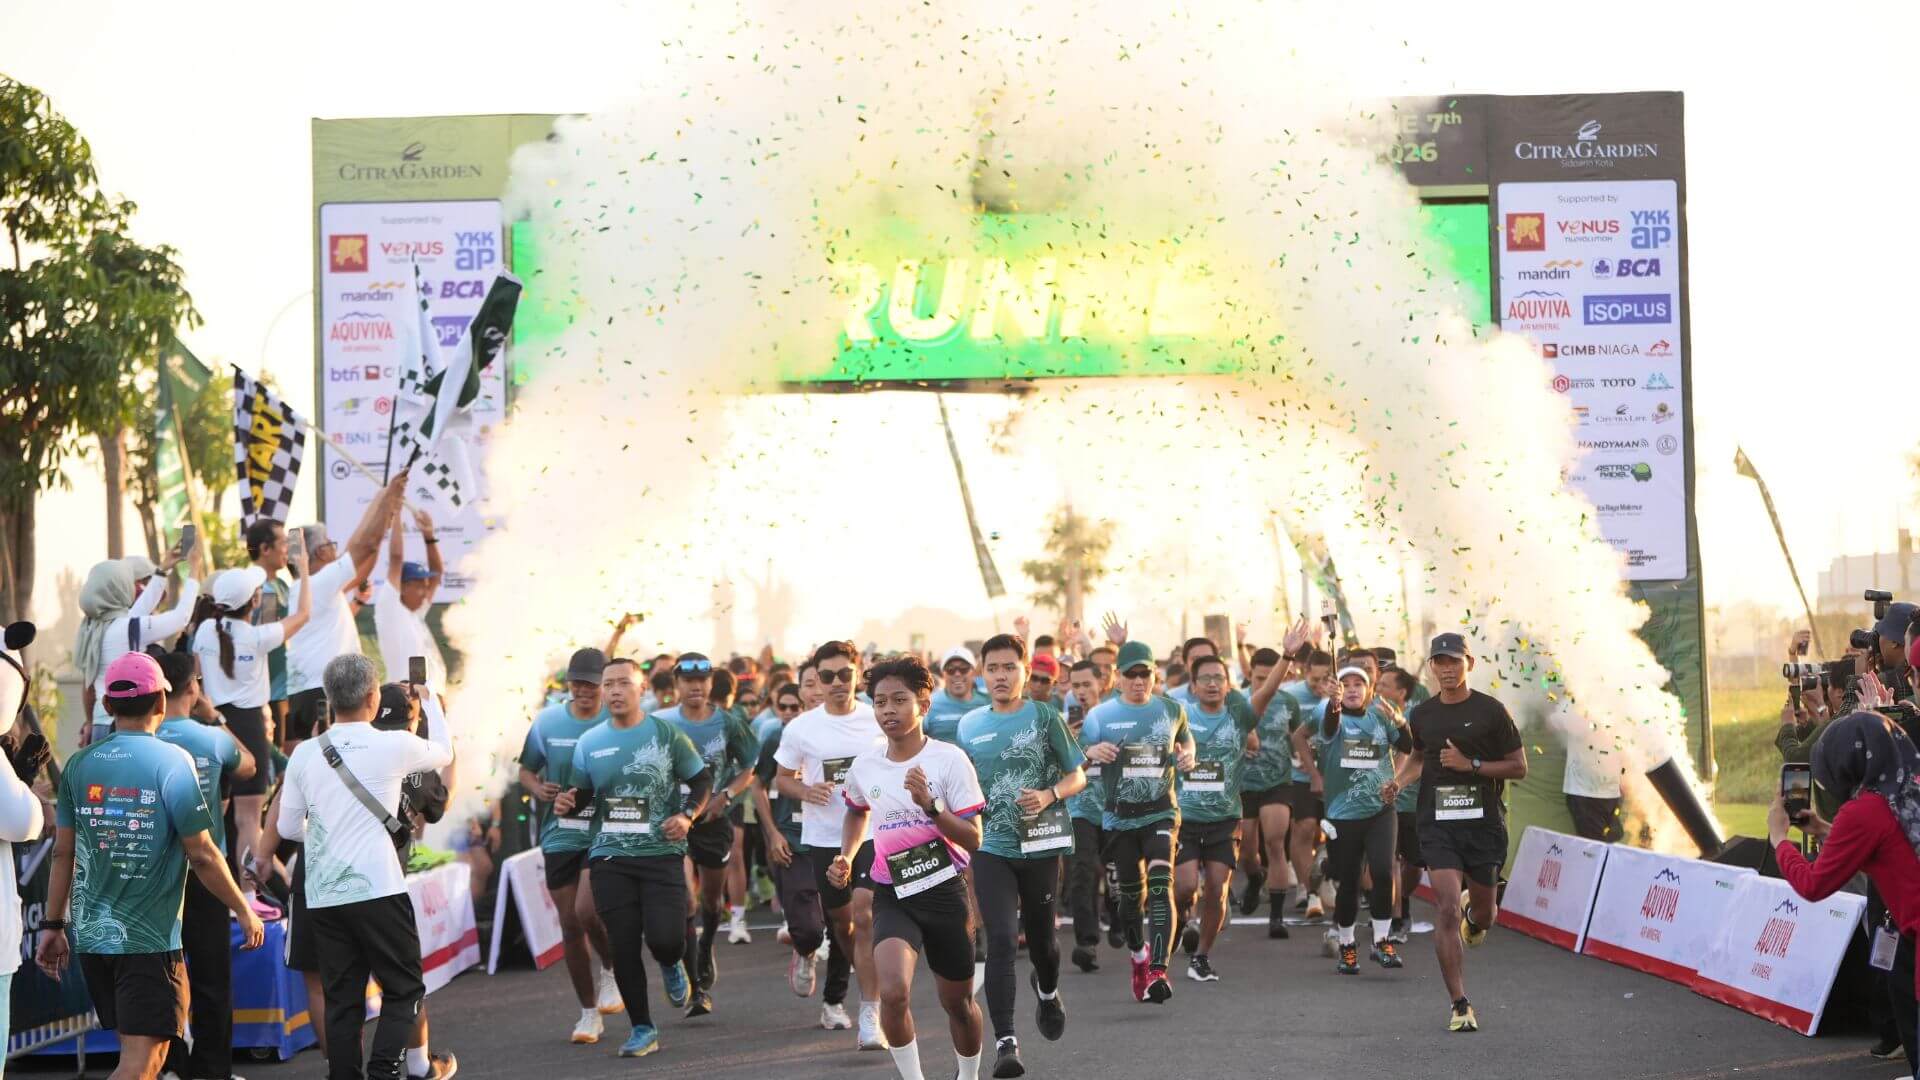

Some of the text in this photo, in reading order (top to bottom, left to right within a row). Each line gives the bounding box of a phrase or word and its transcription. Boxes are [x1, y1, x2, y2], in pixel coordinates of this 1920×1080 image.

[1557, 193, 1605, 204] Supported
[1630, 209, 1671, 226] YKK
[454, 231, 495, 248] YKK
[1616, 258, 1661, 278] BCA
[440, 280, 485, 299] BCA
[1508, 299, 1572, 321] AQUVIVA
[1588, 302, 1667, 321] ISOPLUS
[330, 321, 395, 342] AQUVIVA
[1561, 345, 1596, 356] CIMB
[1598, 344, 1640, 355] NIAGA
[1601, 378, 1636, 388] TOTO
[1577, 440, 1640, 449] HANDYMAN
[900, 857, 940, 879] 500160
[1640, 884, 1680, 923] AQUVIVA
